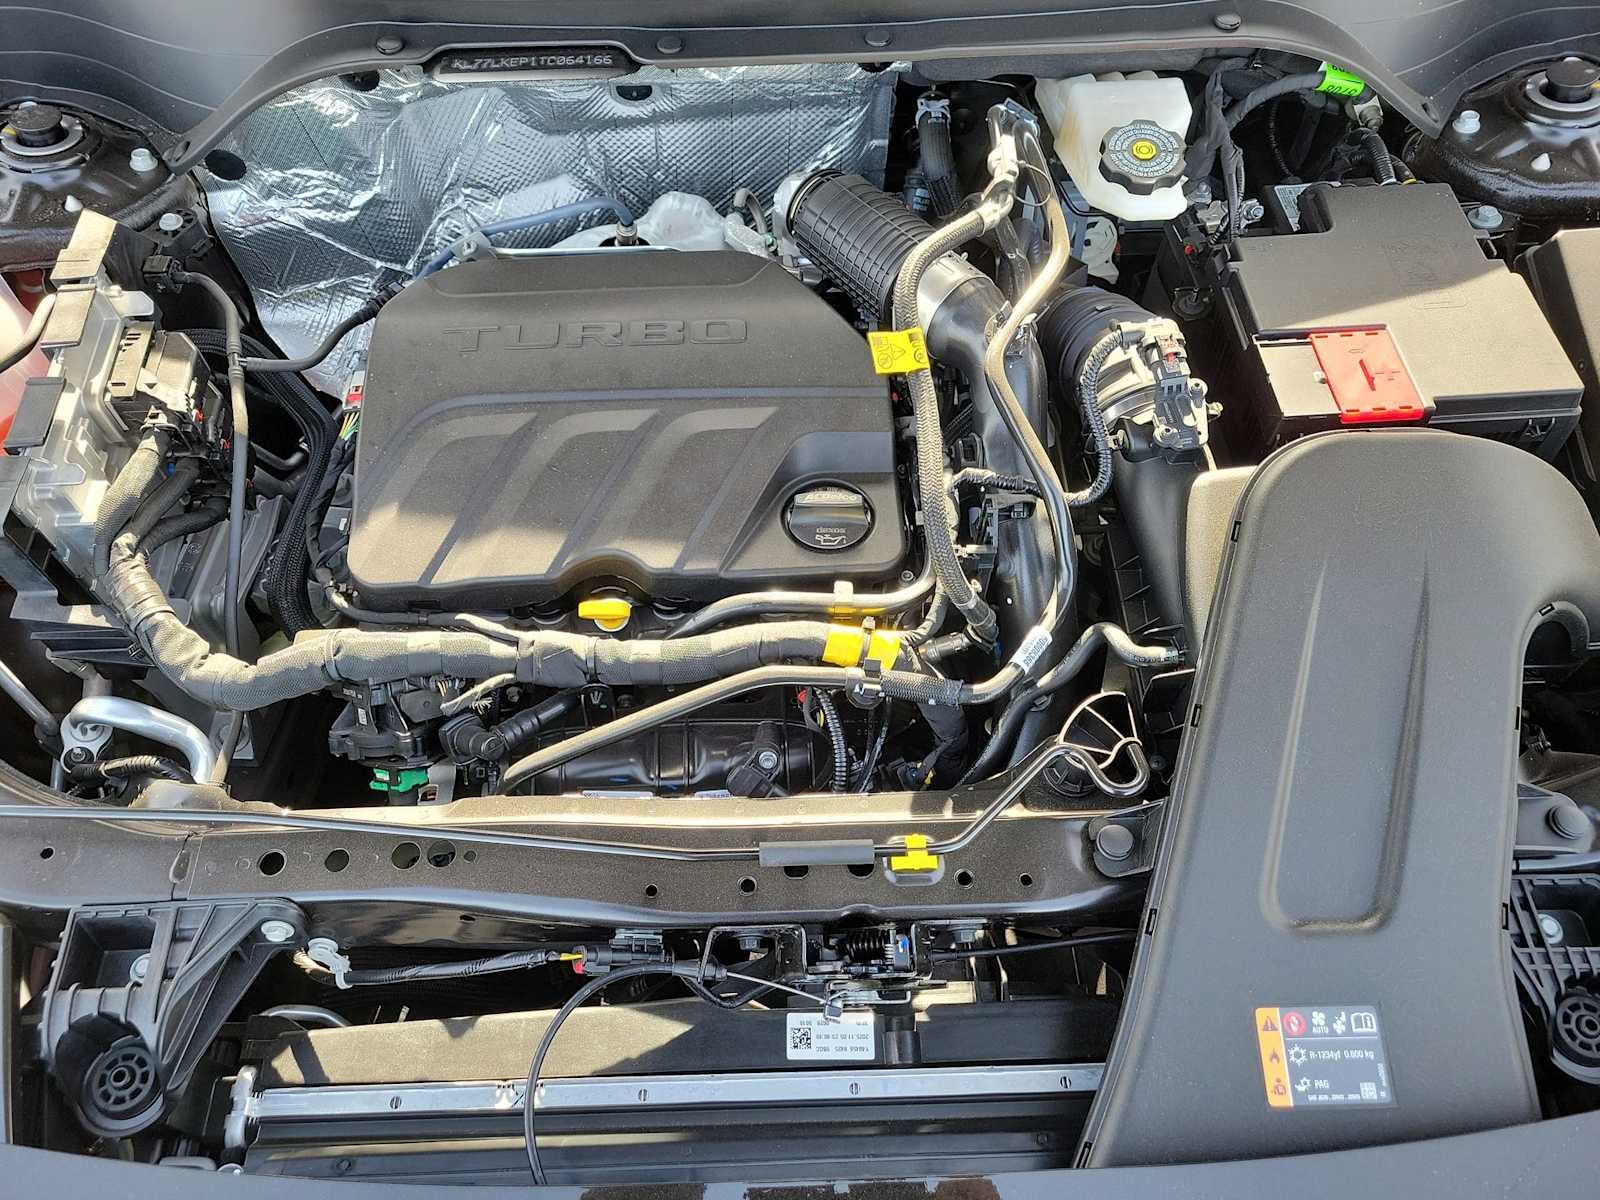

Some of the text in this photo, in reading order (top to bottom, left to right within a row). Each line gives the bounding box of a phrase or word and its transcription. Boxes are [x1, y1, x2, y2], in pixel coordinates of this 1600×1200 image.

[443, 318, 748, 352] TURBO
[1312, 1026, 1329, 1034] AUTO
[1365, 1049, 1374, 1060] kg
[1314, 1080, 1330, 1088] PAG
